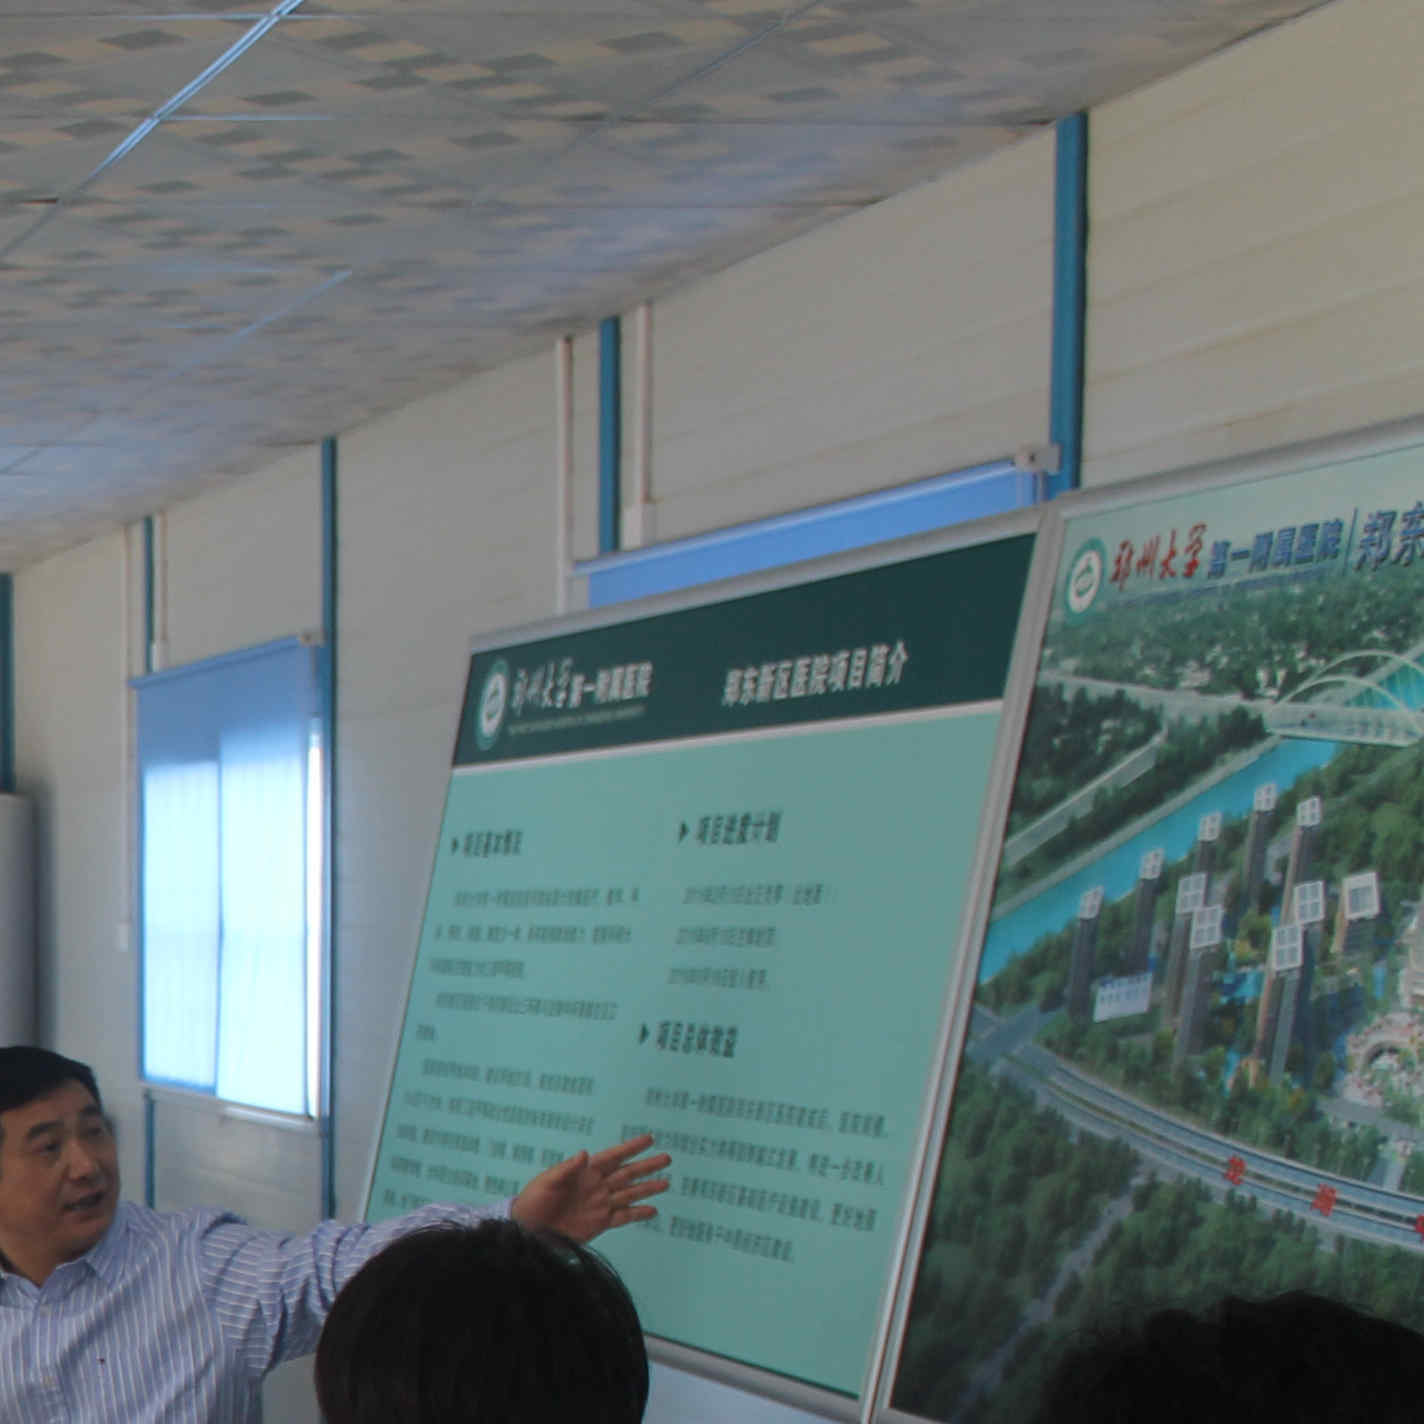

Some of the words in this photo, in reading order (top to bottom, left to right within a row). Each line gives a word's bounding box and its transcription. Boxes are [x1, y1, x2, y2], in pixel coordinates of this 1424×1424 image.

[722, 638, 909, 707] 郑东新区医院项目简介
